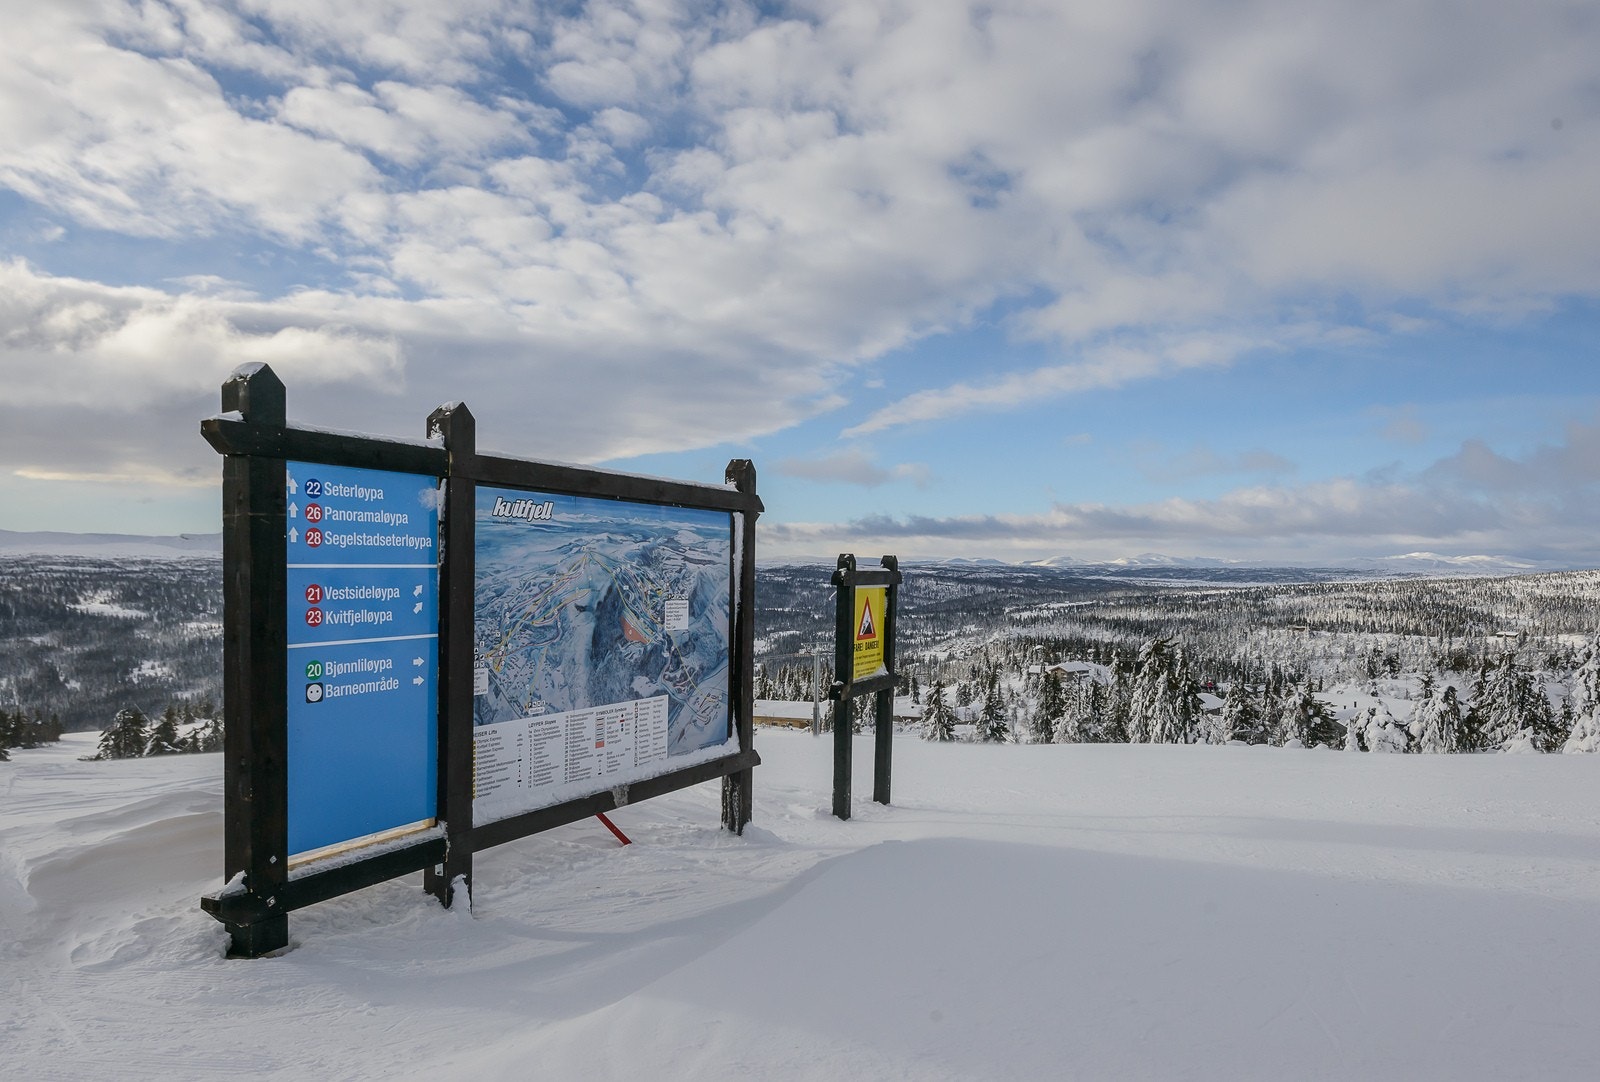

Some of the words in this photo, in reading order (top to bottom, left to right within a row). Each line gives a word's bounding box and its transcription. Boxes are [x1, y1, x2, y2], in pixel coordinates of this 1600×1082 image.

[306, 481, 321, 495] 22
[324, 481, 384, 502] Seterløypa
[306, 506, 321, 520] 26
[324, 506, 409, 526] Panoramaløypa
[306, 531, 321, 545] 28
[324, 530, 432, 550] Segelstadseterløypa
[307, 587, 321, 601] 21
[324, 585, 400, 601] Vestsideløypa
[307, 610, 322, 624] 23
[325, 610, 393, 626] Kvitfjelløypa
[307, 663, 322, 677] 20
[325, 658, 393, 678] Bjønnliløypa
[325, 677, 399, 698] Barneområde
